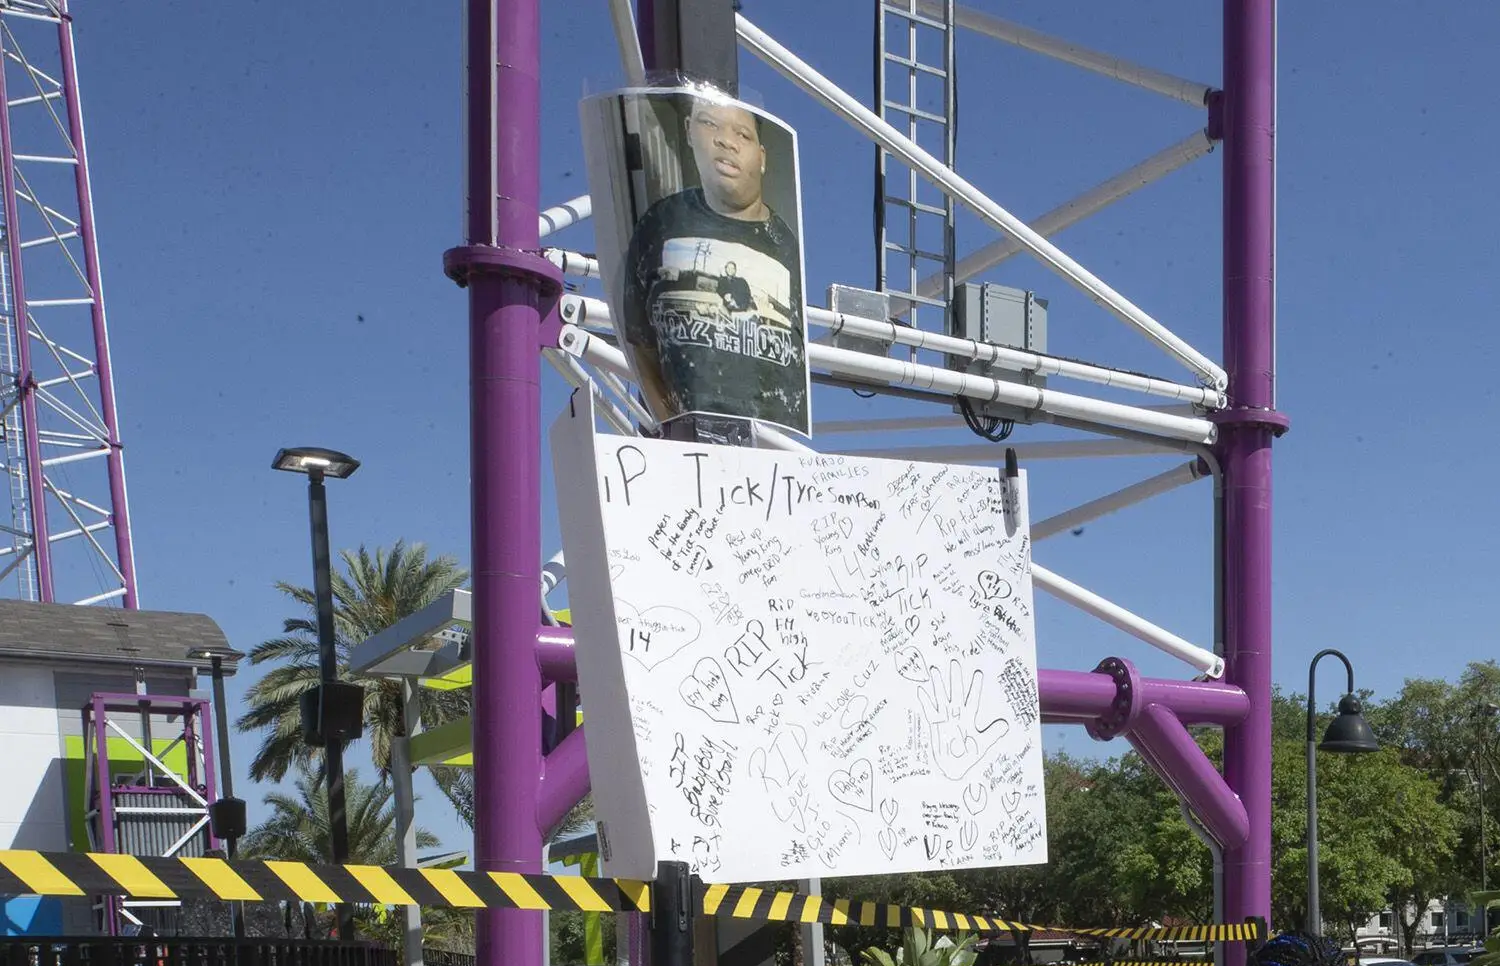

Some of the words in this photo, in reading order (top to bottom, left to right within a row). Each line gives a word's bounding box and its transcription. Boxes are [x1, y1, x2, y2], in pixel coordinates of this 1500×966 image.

[811, 511, 838, 534] RIP
[629, 628, 651, 652] 14
[724, 618, 771, 677] RIP
